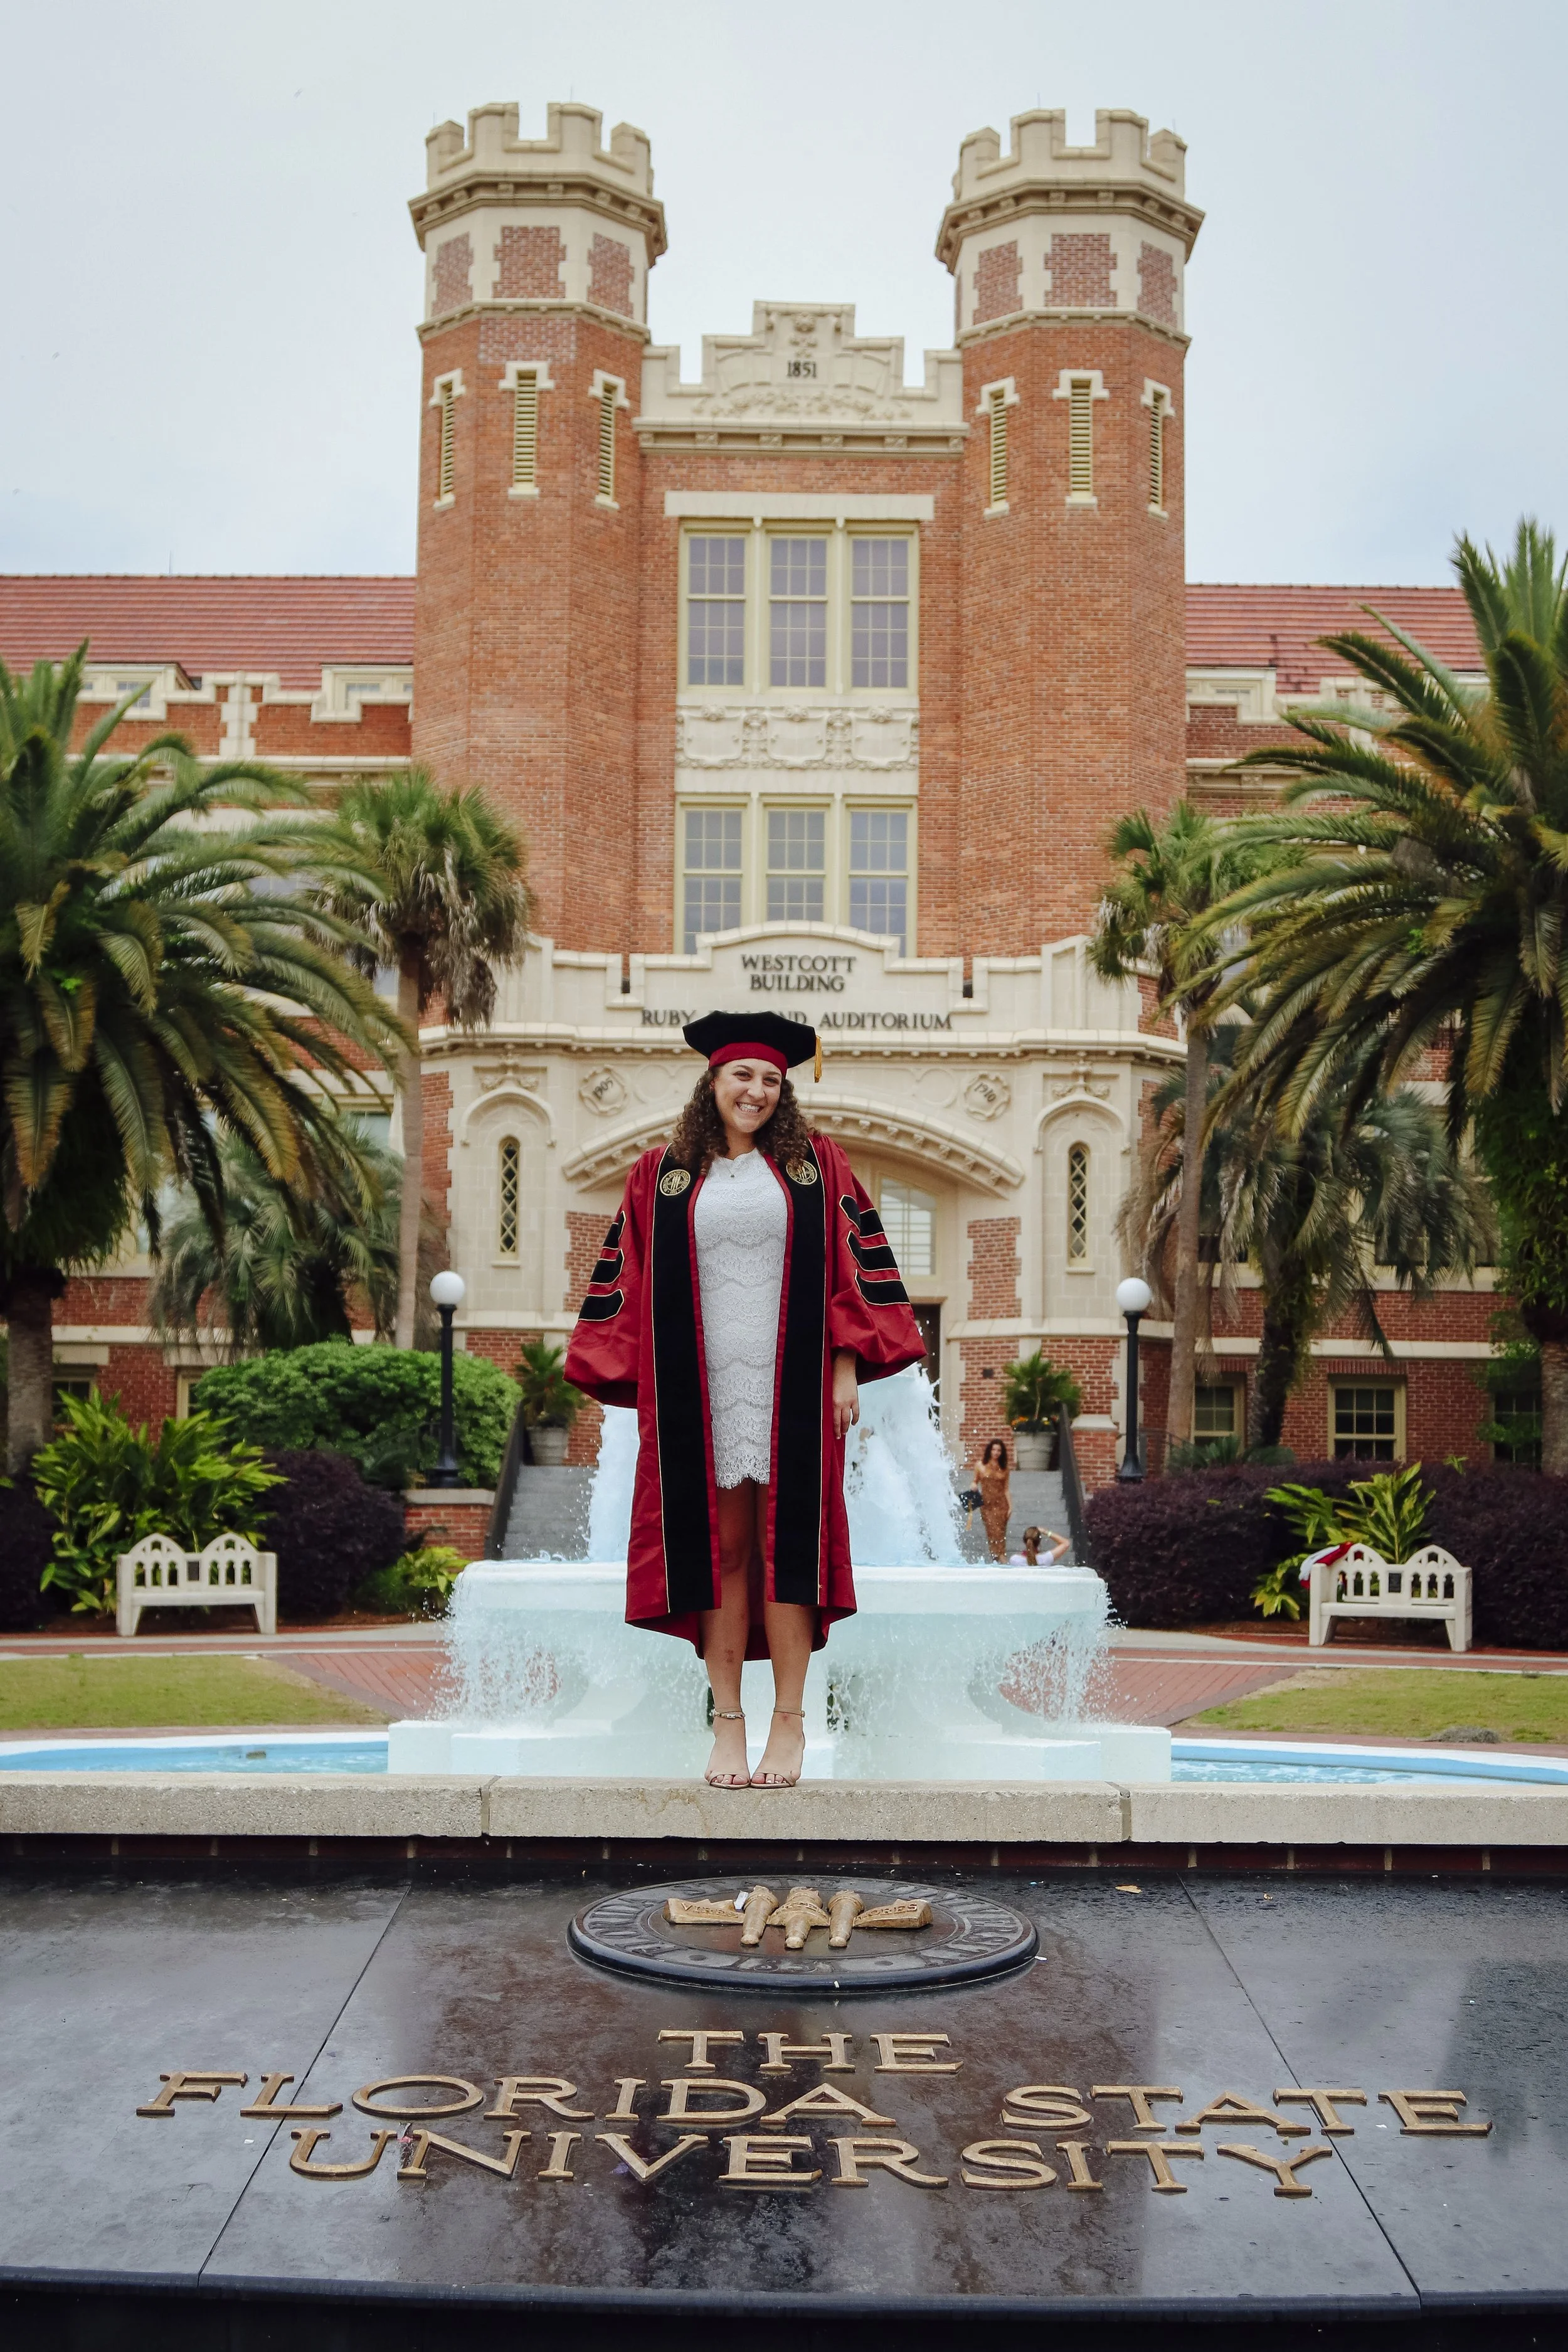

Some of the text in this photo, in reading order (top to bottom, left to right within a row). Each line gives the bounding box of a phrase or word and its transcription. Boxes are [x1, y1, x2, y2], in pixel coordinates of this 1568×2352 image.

[787, 361, 817, 378] 1851
[741, 954, 856, 972] WESTCOTT
[750, 973, 845, 992] BUILDING
[641, 1009, 696, 1025] RUBY
[818, 1011, 952, 1030] AUDITORIUM
[591, 1076, 613, 1100] 1905
[973, 1082, 997, 1102] 1910
[657, 2030, 964, 2074] THE
[136, 2071, 1492, 2136] FLORIDA STATE
[289, 2128, 1332, 2197] UNIVERSITY
